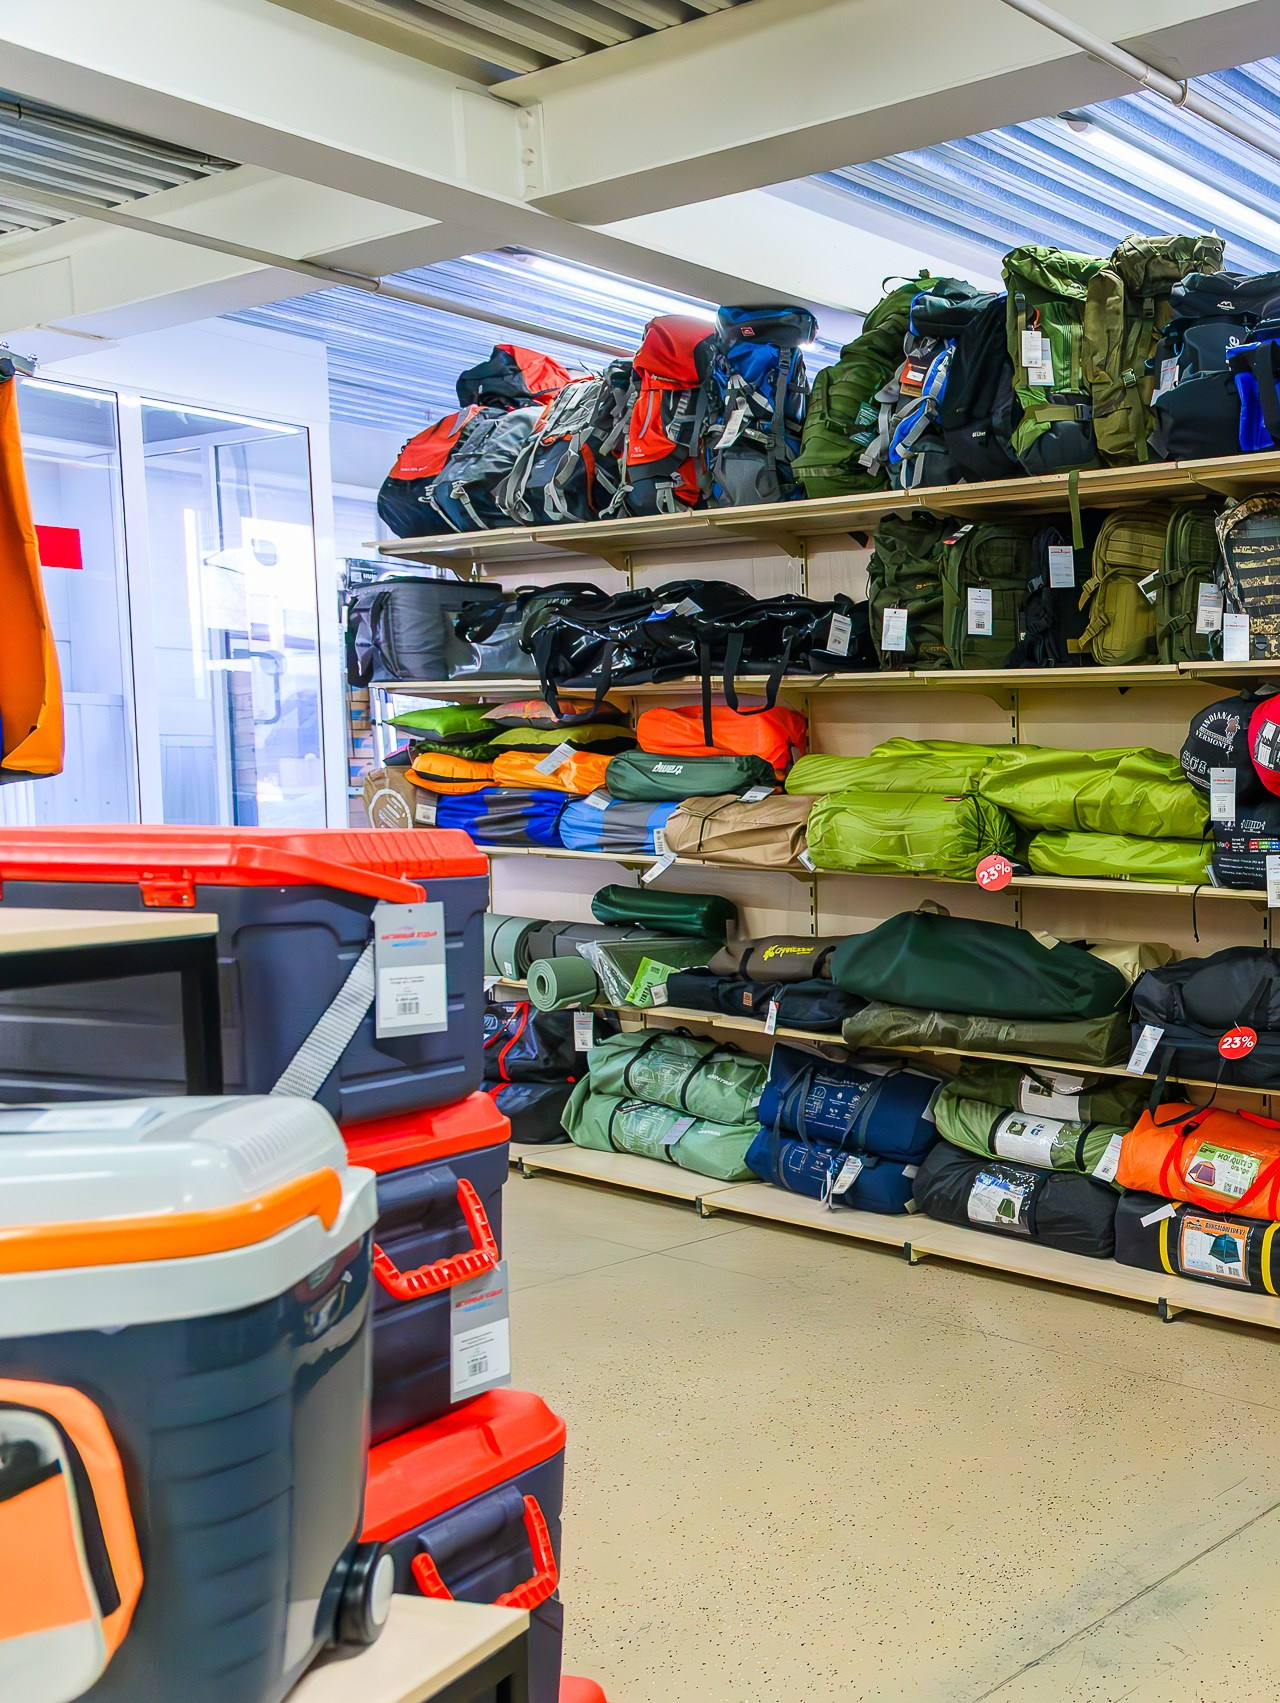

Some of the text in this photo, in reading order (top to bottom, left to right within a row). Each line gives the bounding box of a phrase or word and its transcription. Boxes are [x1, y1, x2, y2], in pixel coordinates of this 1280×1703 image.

[1202, 711, 1232, 729] INDIANA
[1195, 729, 1228, 751] VERMONT
[652, 762, 684, 775] tramp
[979, 861, 1011, 885] 23%
[1221, 1036, 1254, 1049] 23%
